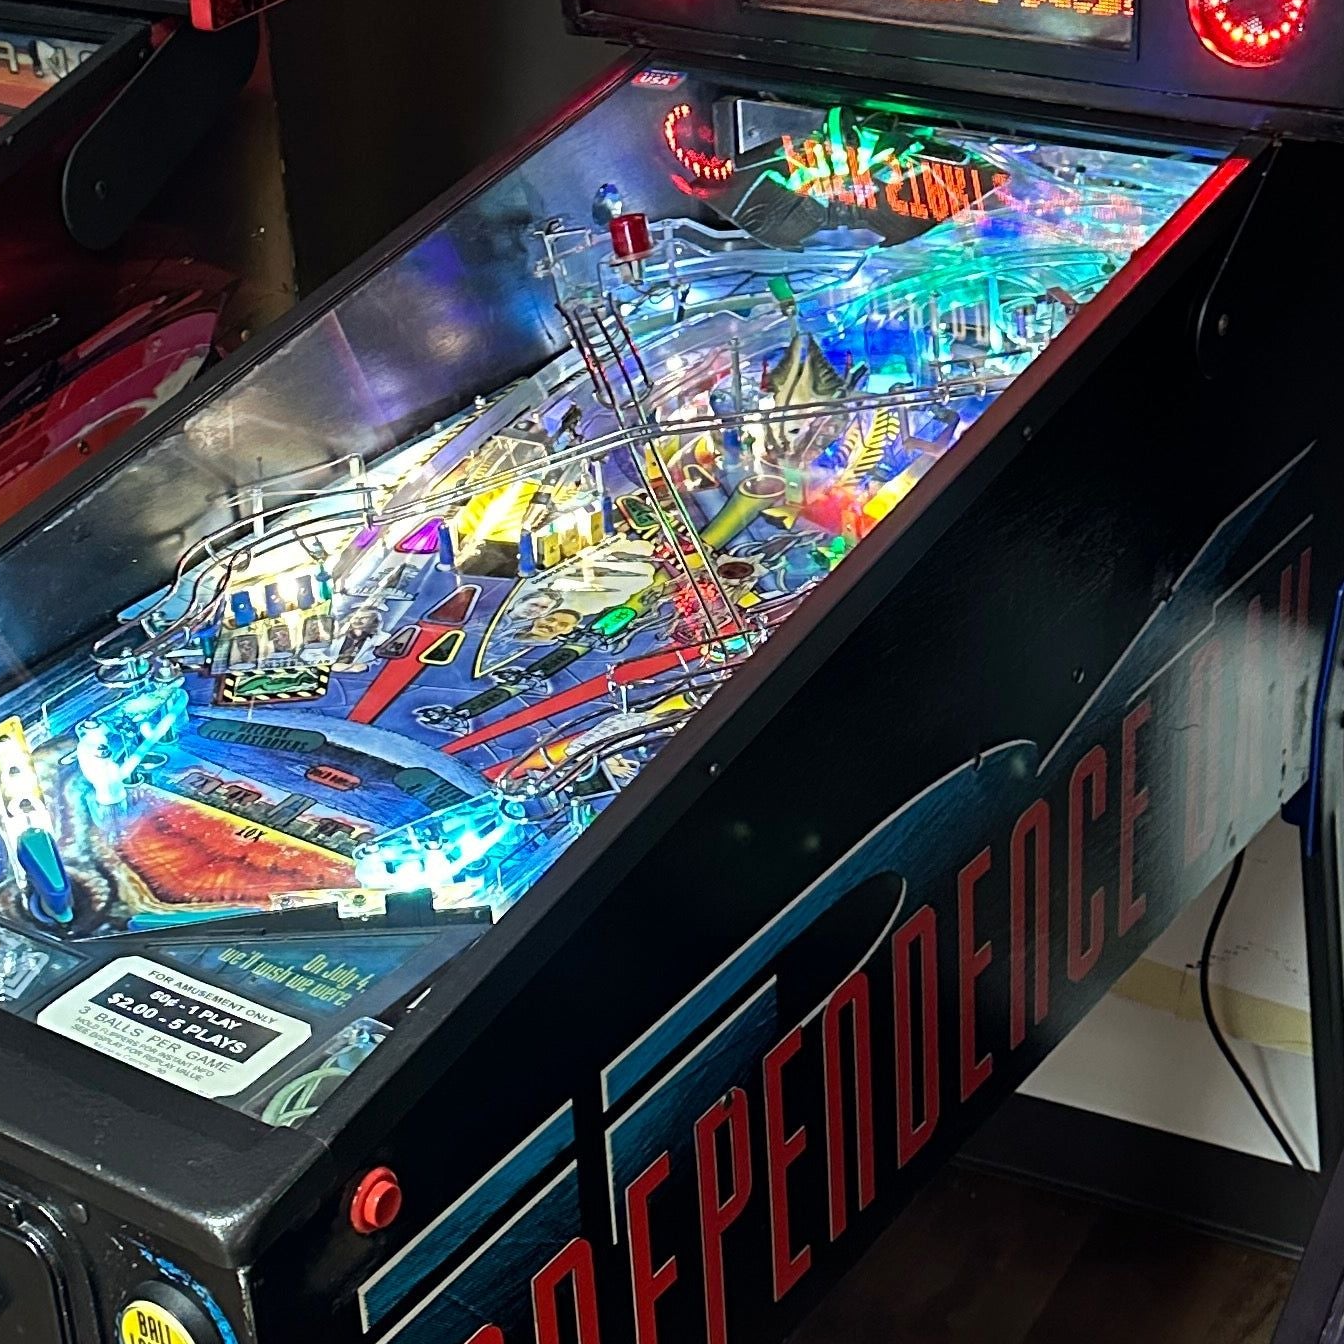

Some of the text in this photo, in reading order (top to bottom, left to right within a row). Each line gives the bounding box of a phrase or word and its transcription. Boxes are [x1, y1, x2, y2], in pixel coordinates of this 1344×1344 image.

[639, 75, 672, 86] USA
[234, 825, 267, 841] 10X
[218, 948, 353, 1008] we'll wish we were.
[303, 954, 329, 975] On
[322, 963, 359, 990] July
[148, 969, 277, 1026] FOR AMUSEMENT ONLY
[78, 1005, 91, 1016] 3
[93, 1009, 145, 1039] BALLS
[147, 1034, 182, 1055] PER
[184, 1049, 235, 1074] GAME
[106, 992, 159, 1020] $2.00
[167, 1017, 182, 1032] 5
[182, 1023, 249, 1055] PLAYS
[197, 1009, 243, 1031] PLAY
[87, 1030, 125, 1048] DISPLAY
[122, 1045, 145, 1056] FOR
[141, 1053, 176, 1069] REPLAY
[174, 1066, 204, 1081] VALUE
[137, 1043, 159, 1054] FOR
[156, 1051, 194, 1069] INSTANT
